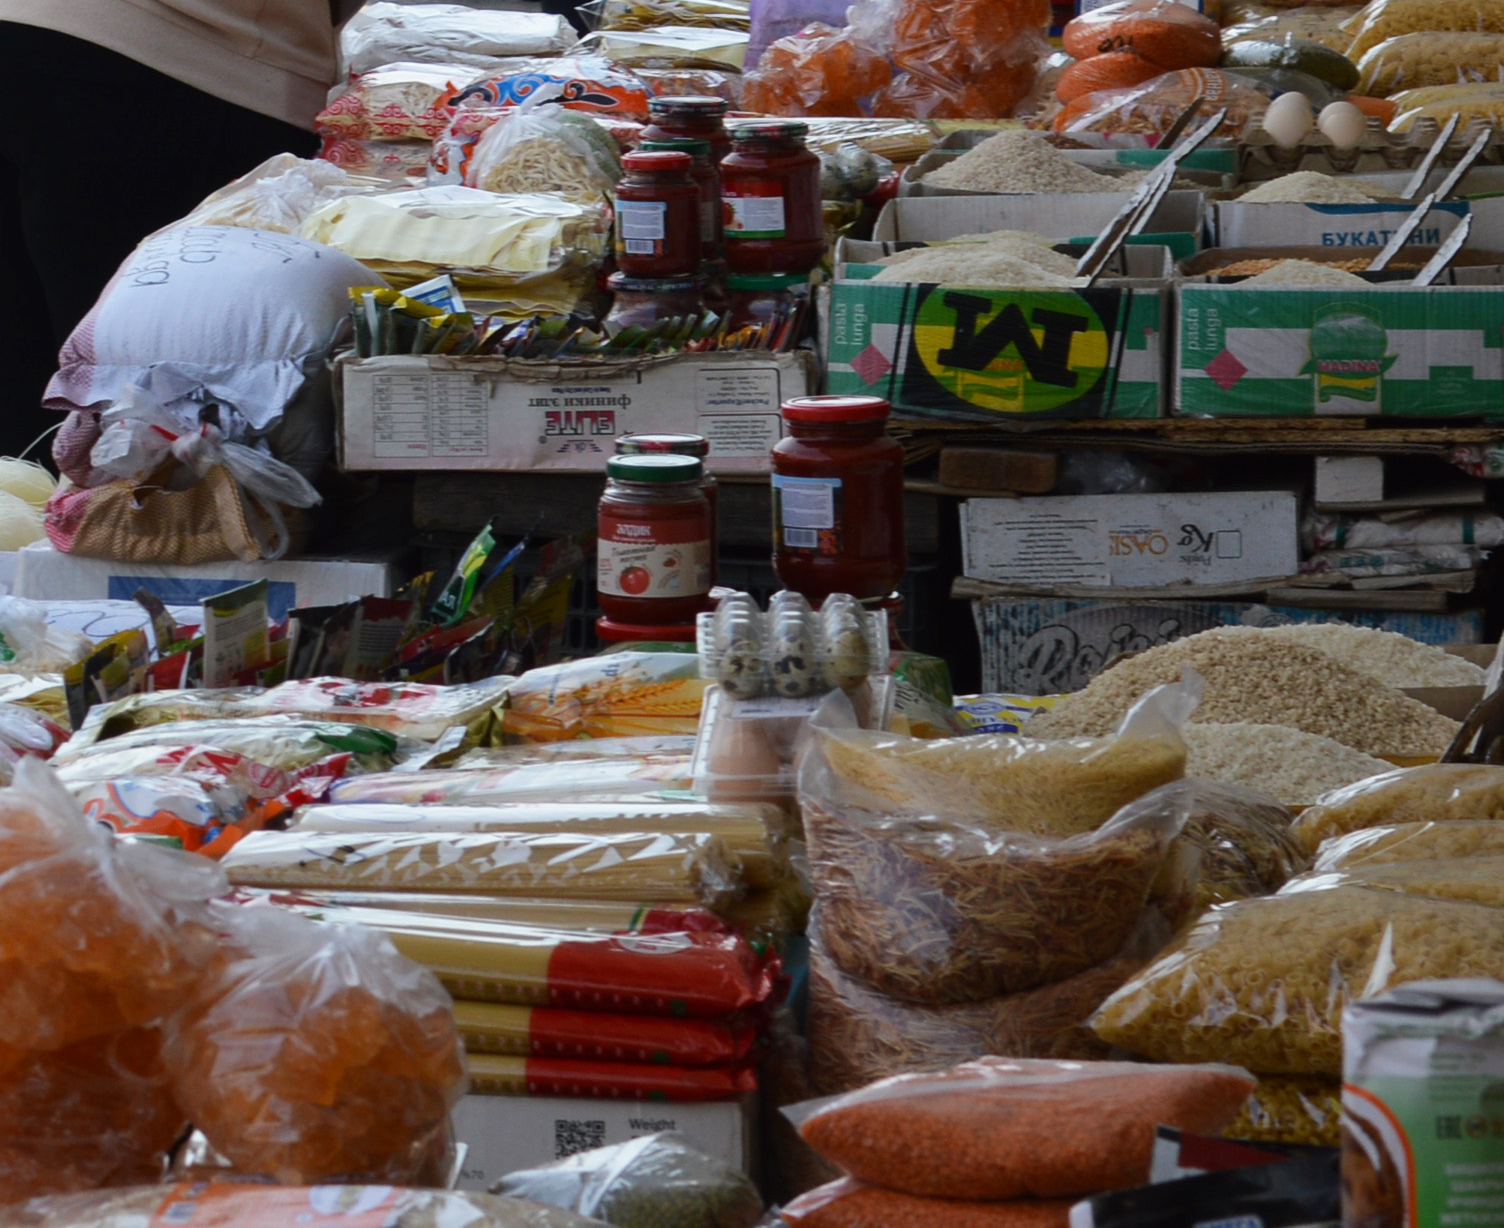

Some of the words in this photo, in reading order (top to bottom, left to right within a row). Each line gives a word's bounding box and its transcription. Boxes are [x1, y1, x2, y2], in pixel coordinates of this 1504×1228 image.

[1322, 228, 1440, 247] БУКАТНИ
[834, 303, 848, 345] pasta
[852, 303, 866, 346] lunga
[1188, 309, 1200, 350] pasta
[1205, 309, 1219, 351] lunga
[1317, 359, 1380, 372] MADINA
[527, 397, 559, 407] элит
[564, 393, 631, 409] финики
[544, 410, 615, 435] ELITE
[1177, 524, 1214, 553] Kg
[629, 1117, 676, 1133] Weight
